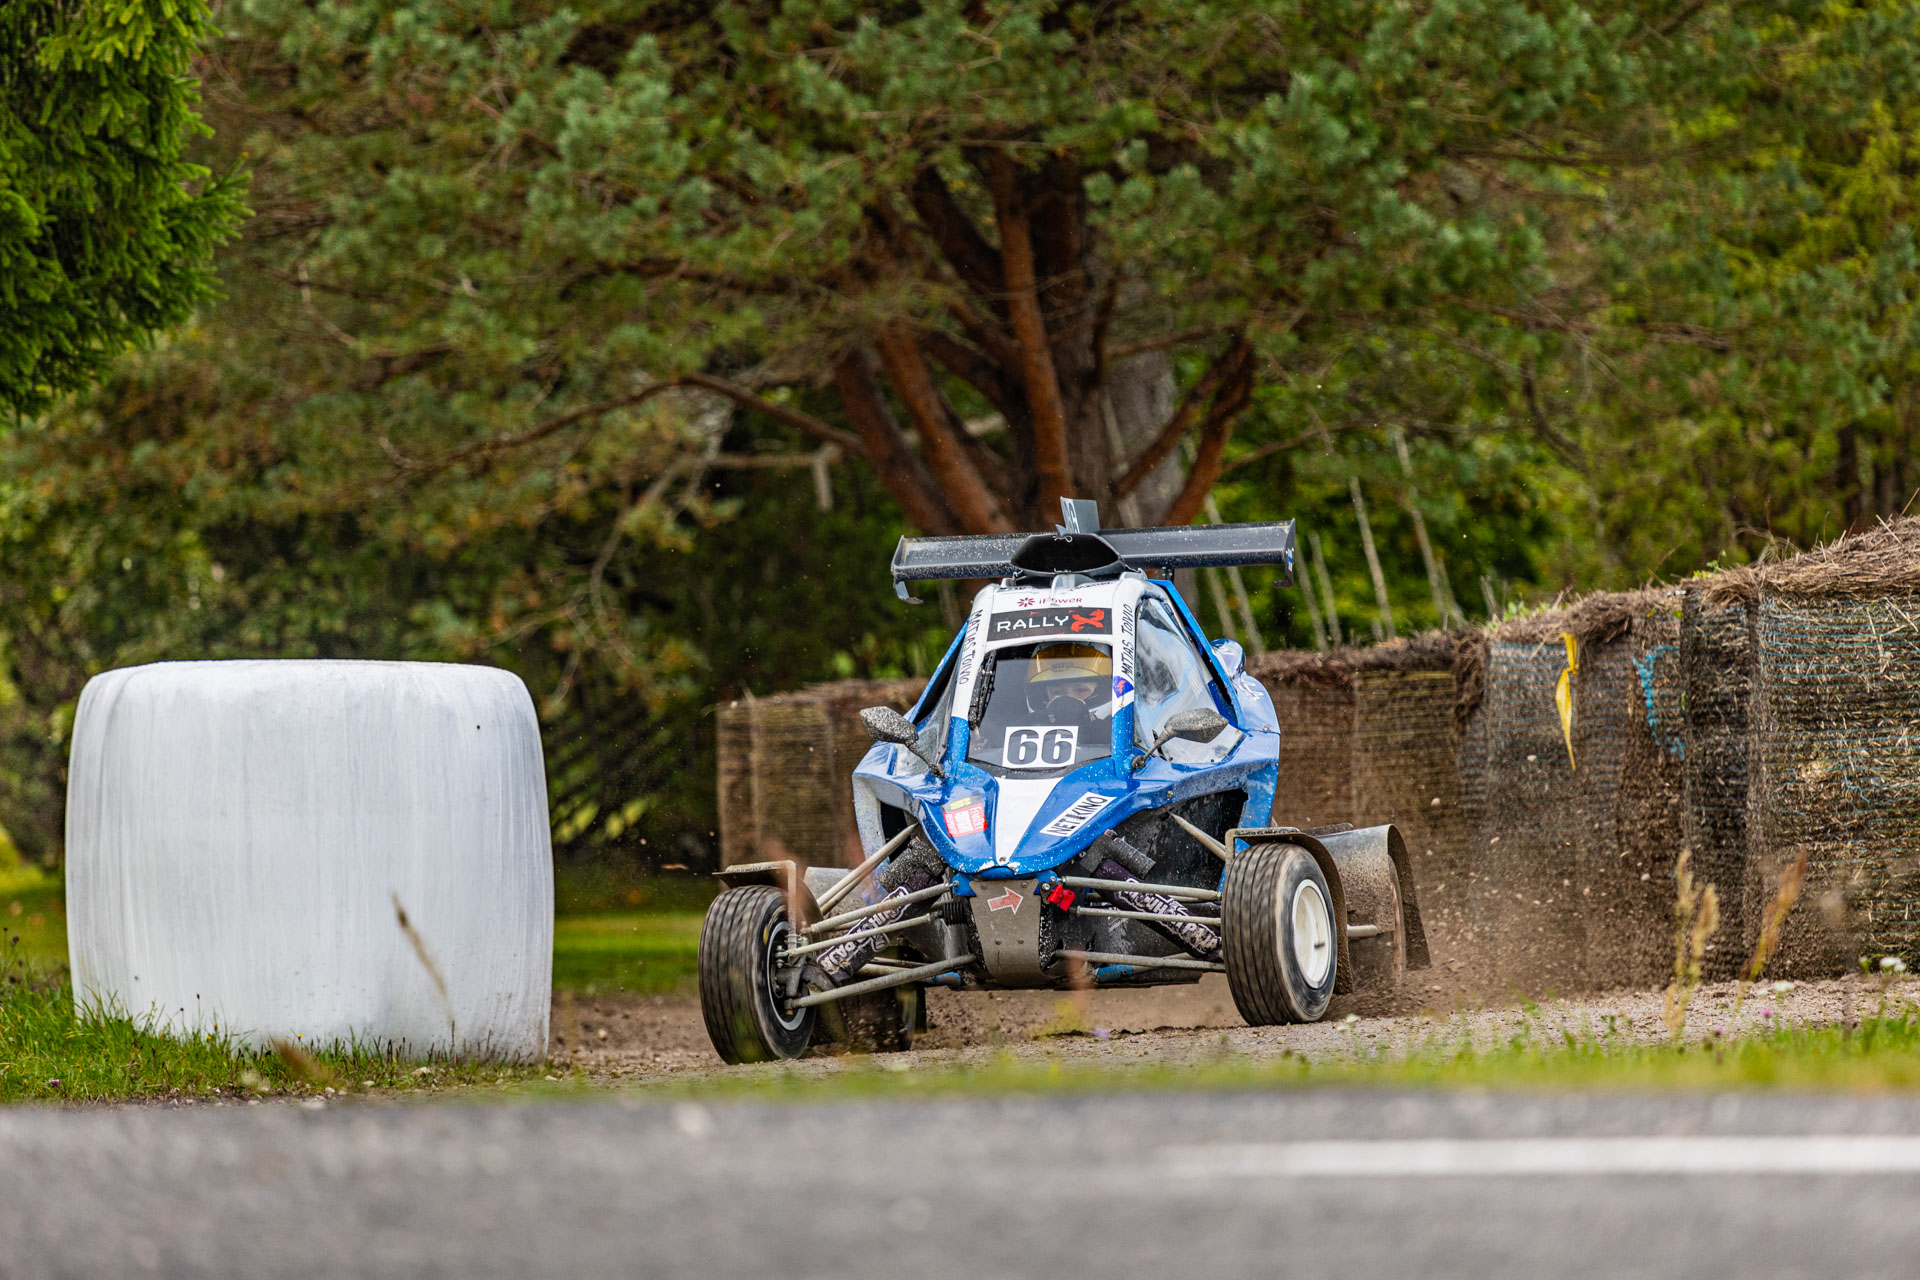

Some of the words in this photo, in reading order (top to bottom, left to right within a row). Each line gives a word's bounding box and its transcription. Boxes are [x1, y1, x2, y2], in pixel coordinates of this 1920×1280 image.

[963, 609, 983, 651] MATIAS
[1121, 604, 1134, 636] TOIVIO
[1121, 640, 1134, 680] MATIAS
[1006, 729, 1074, 765] 66
